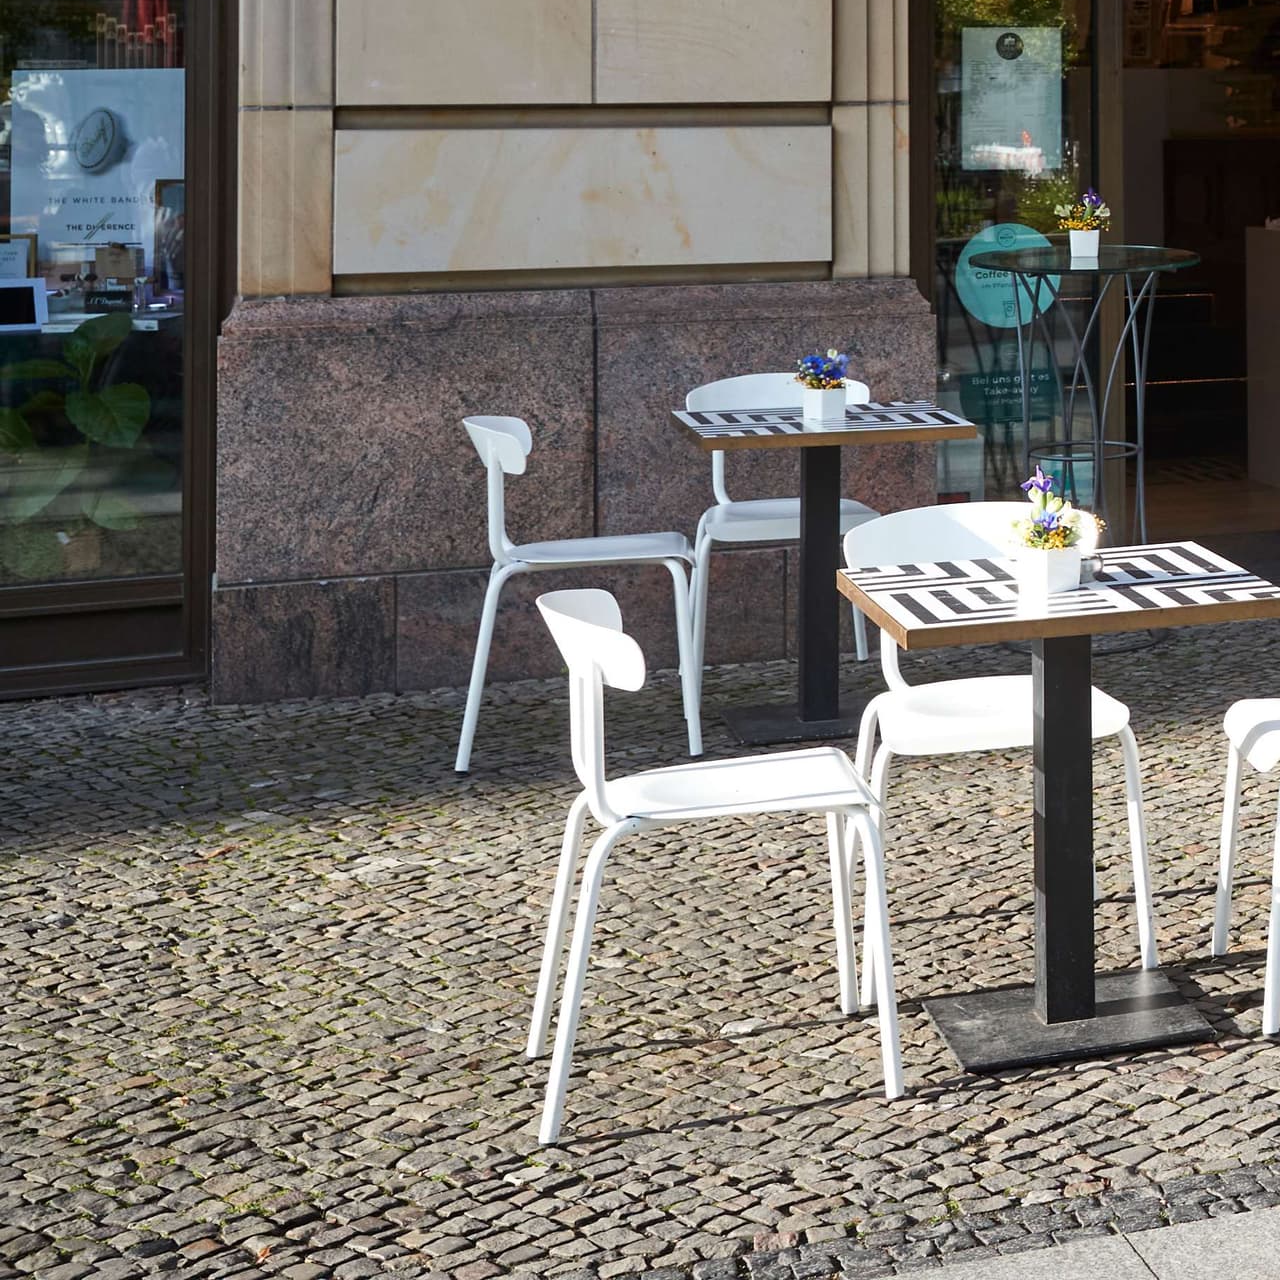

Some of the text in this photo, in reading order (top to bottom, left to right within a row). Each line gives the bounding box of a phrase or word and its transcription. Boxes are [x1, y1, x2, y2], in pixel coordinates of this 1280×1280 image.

[48, 196, 67, 205] THE
[72, 196, 105, 205] WHITE
[66, 223, 83, 232] THE
[975, 270, 1009, 280] Coffee
[992, 375, 1011, 384] uns
